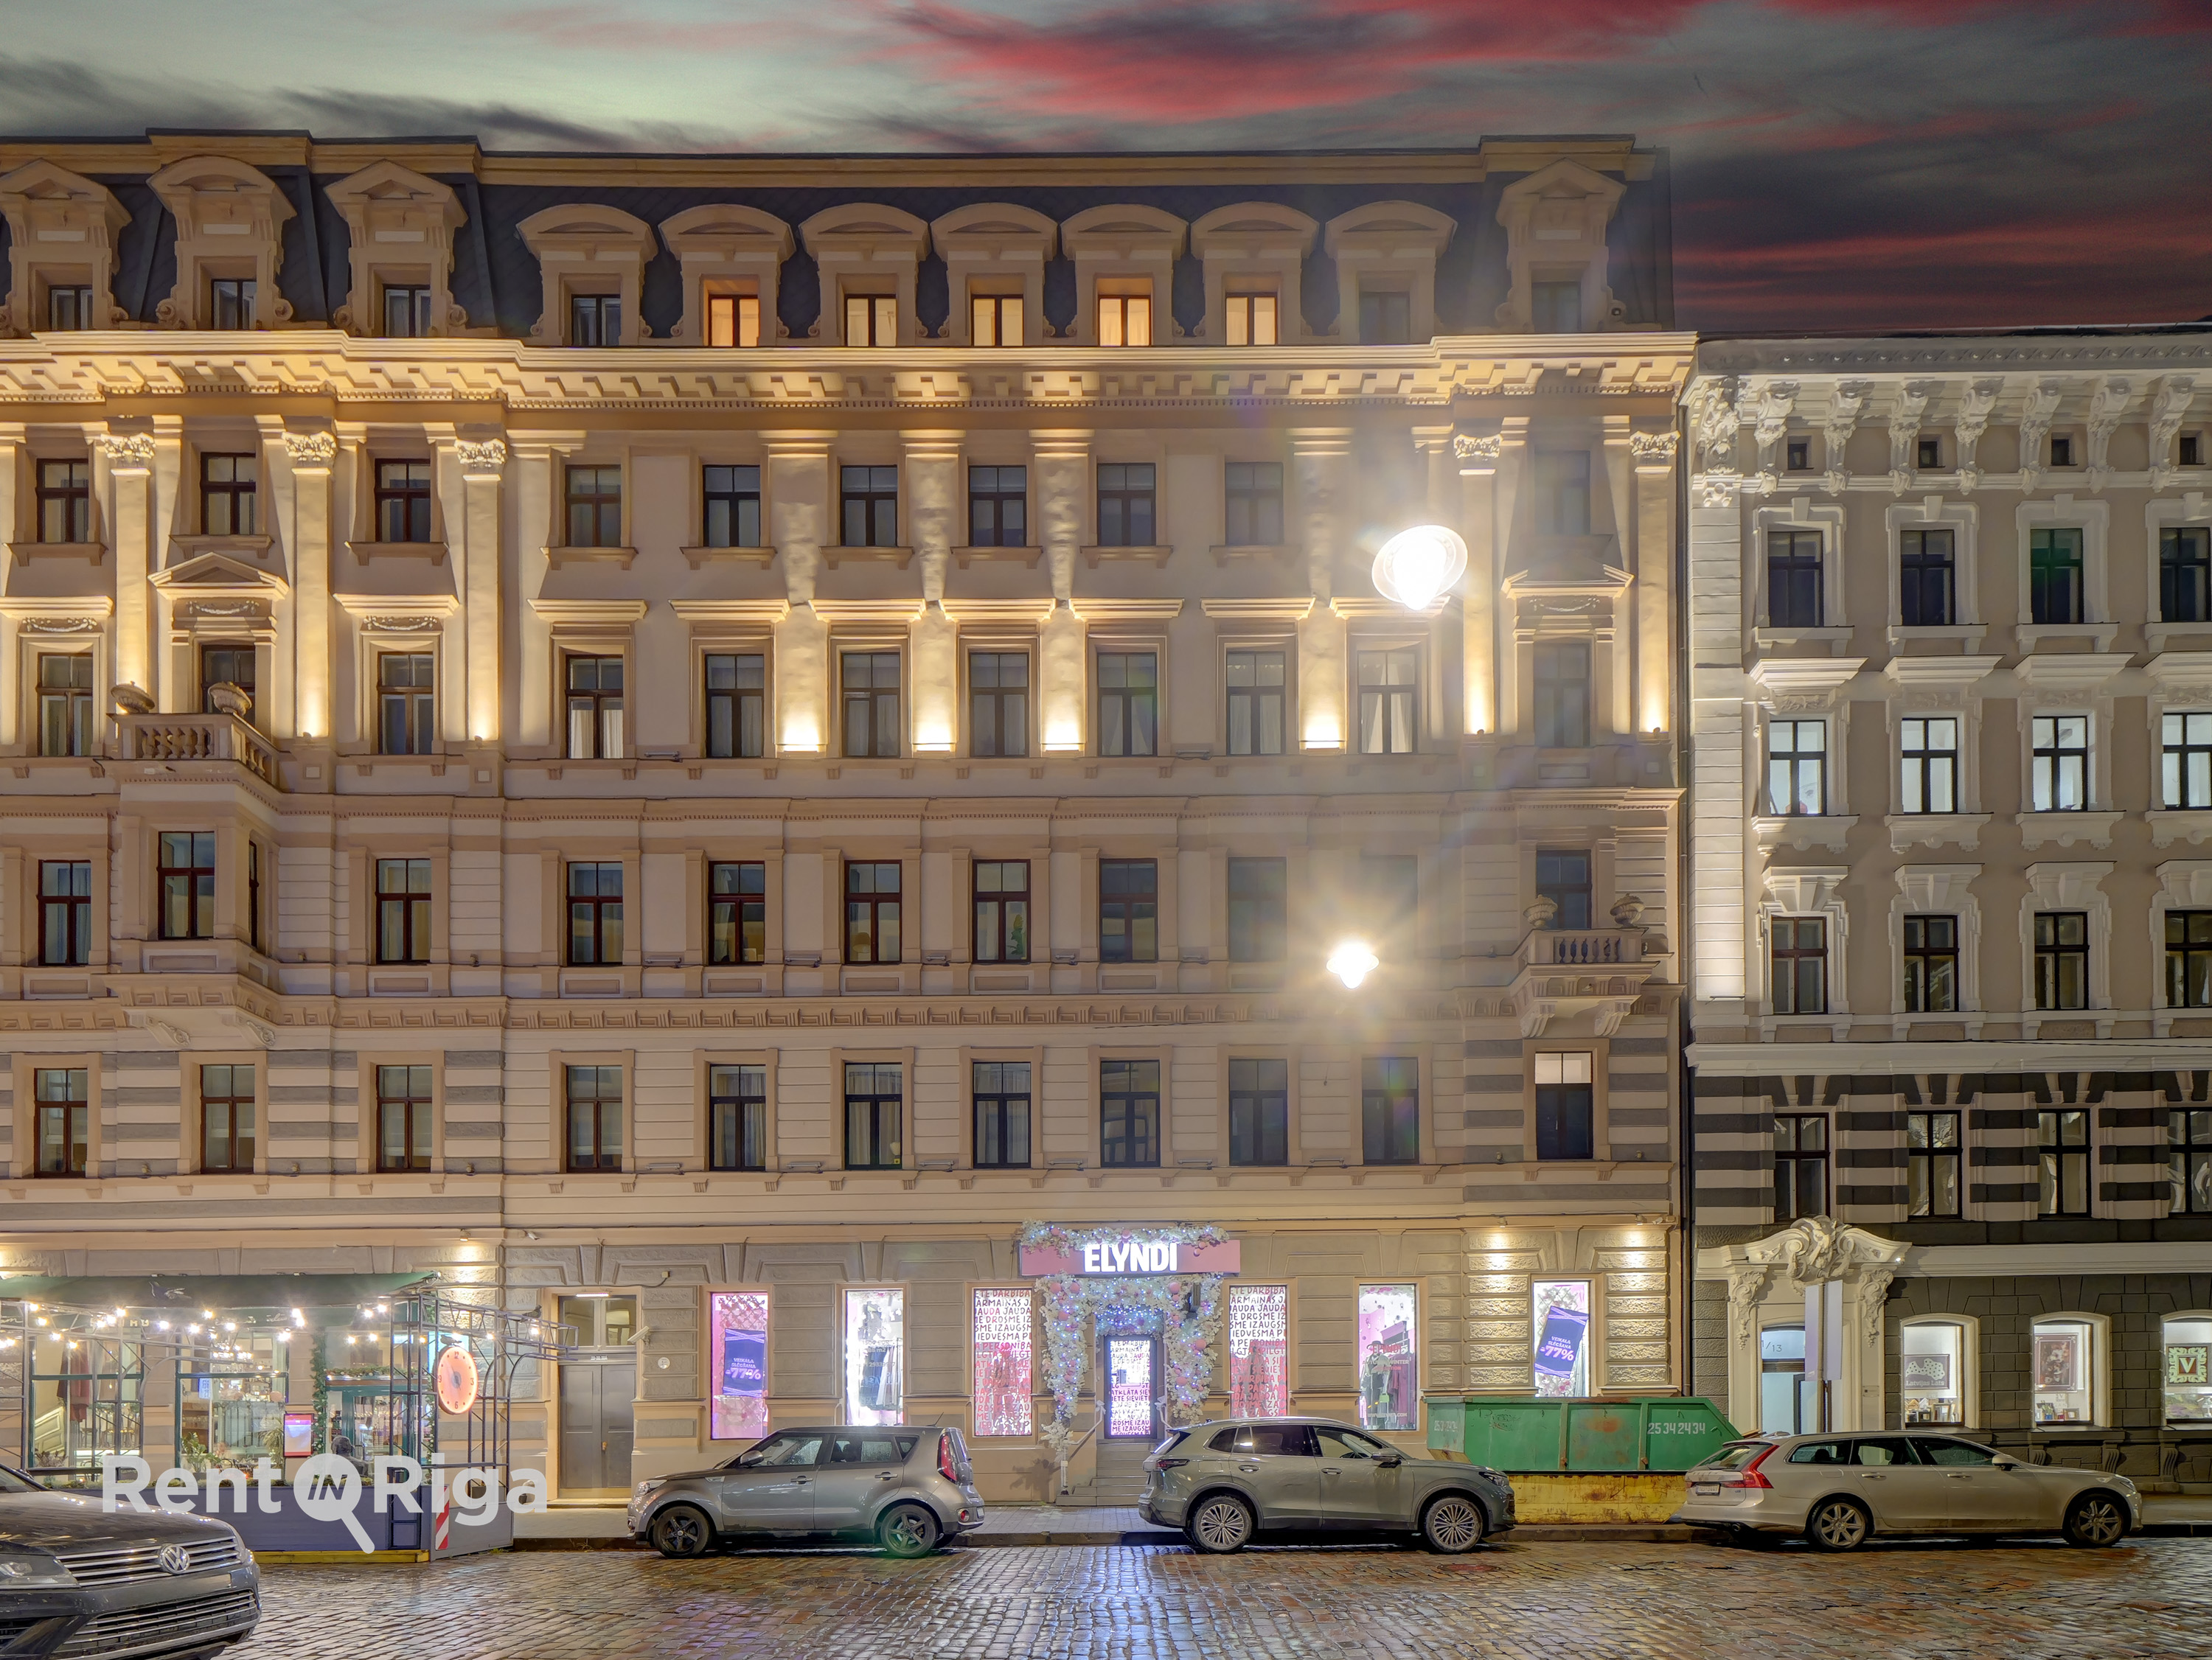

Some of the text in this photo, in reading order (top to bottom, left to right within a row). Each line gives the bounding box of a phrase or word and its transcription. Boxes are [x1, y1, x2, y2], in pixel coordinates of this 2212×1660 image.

[1085, 1243, 1178, 1272] ELYNDI
[986, 1316, 1020, 1324] DROSME
[978, 1333, 1020, 1341] IEDVESMA
[1232, 1329, 1275, 1338] IEDVESMA
[1540, 1345, 1574, 1361] -77%
[725, 1367, 762, 1380] -77%
[470, 1378, 474, 1386] 3
[454, 1401, 459, 1409] 6
